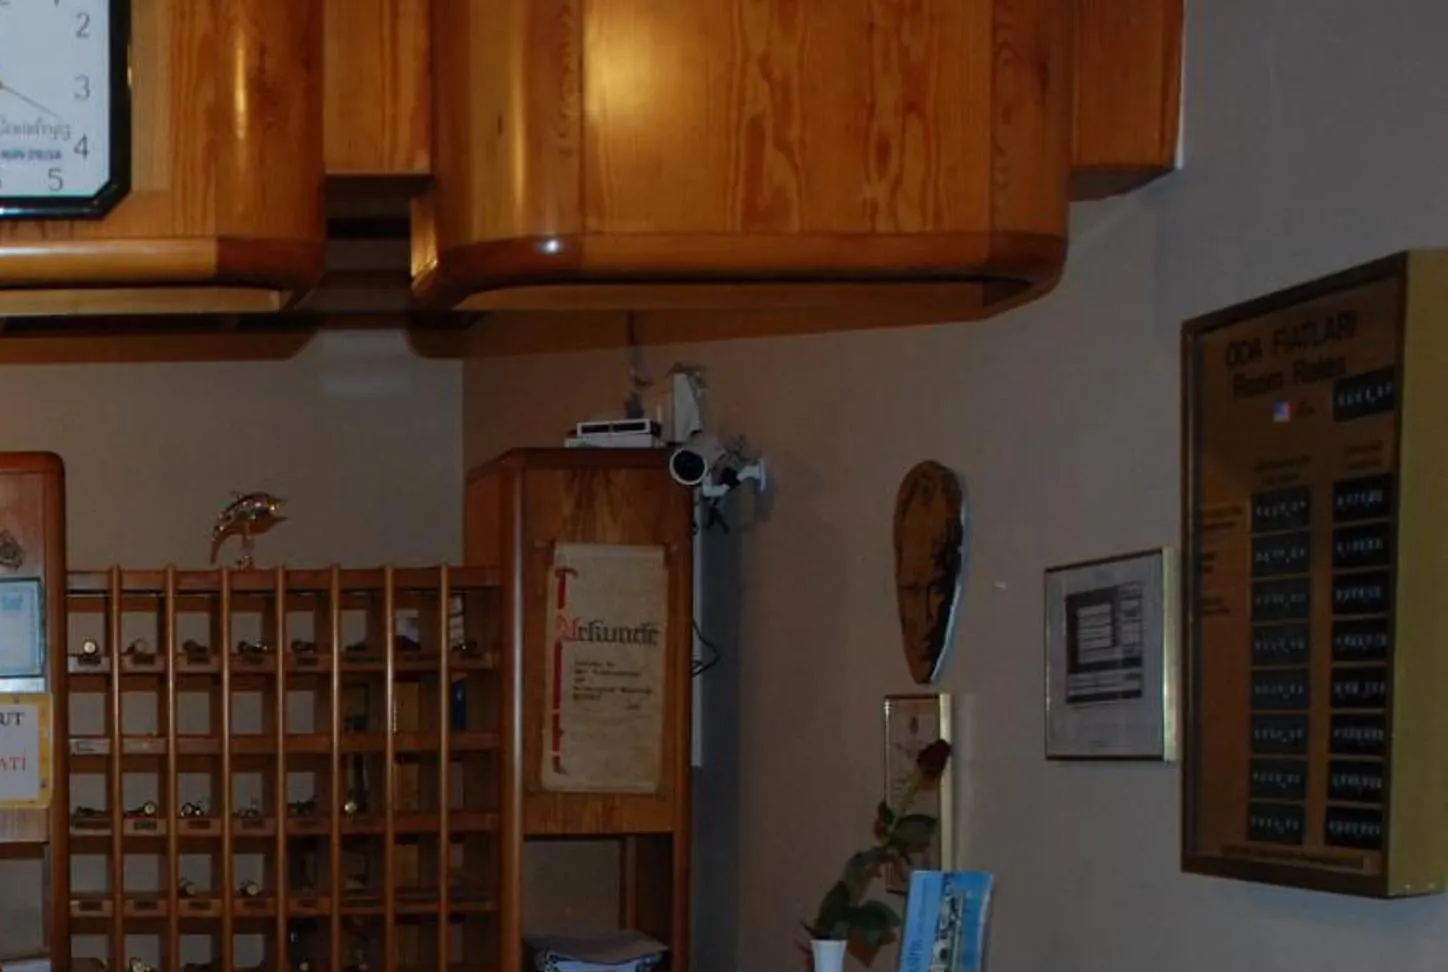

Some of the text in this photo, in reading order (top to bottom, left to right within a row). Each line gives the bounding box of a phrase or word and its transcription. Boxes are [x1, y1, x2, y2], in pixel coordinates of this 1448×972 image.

[74, 13, 91, 39] 2
[74, 74, 91, 101] 3
[73, 134, 90, 159] 4
[47, 167, 64, 192] 5
